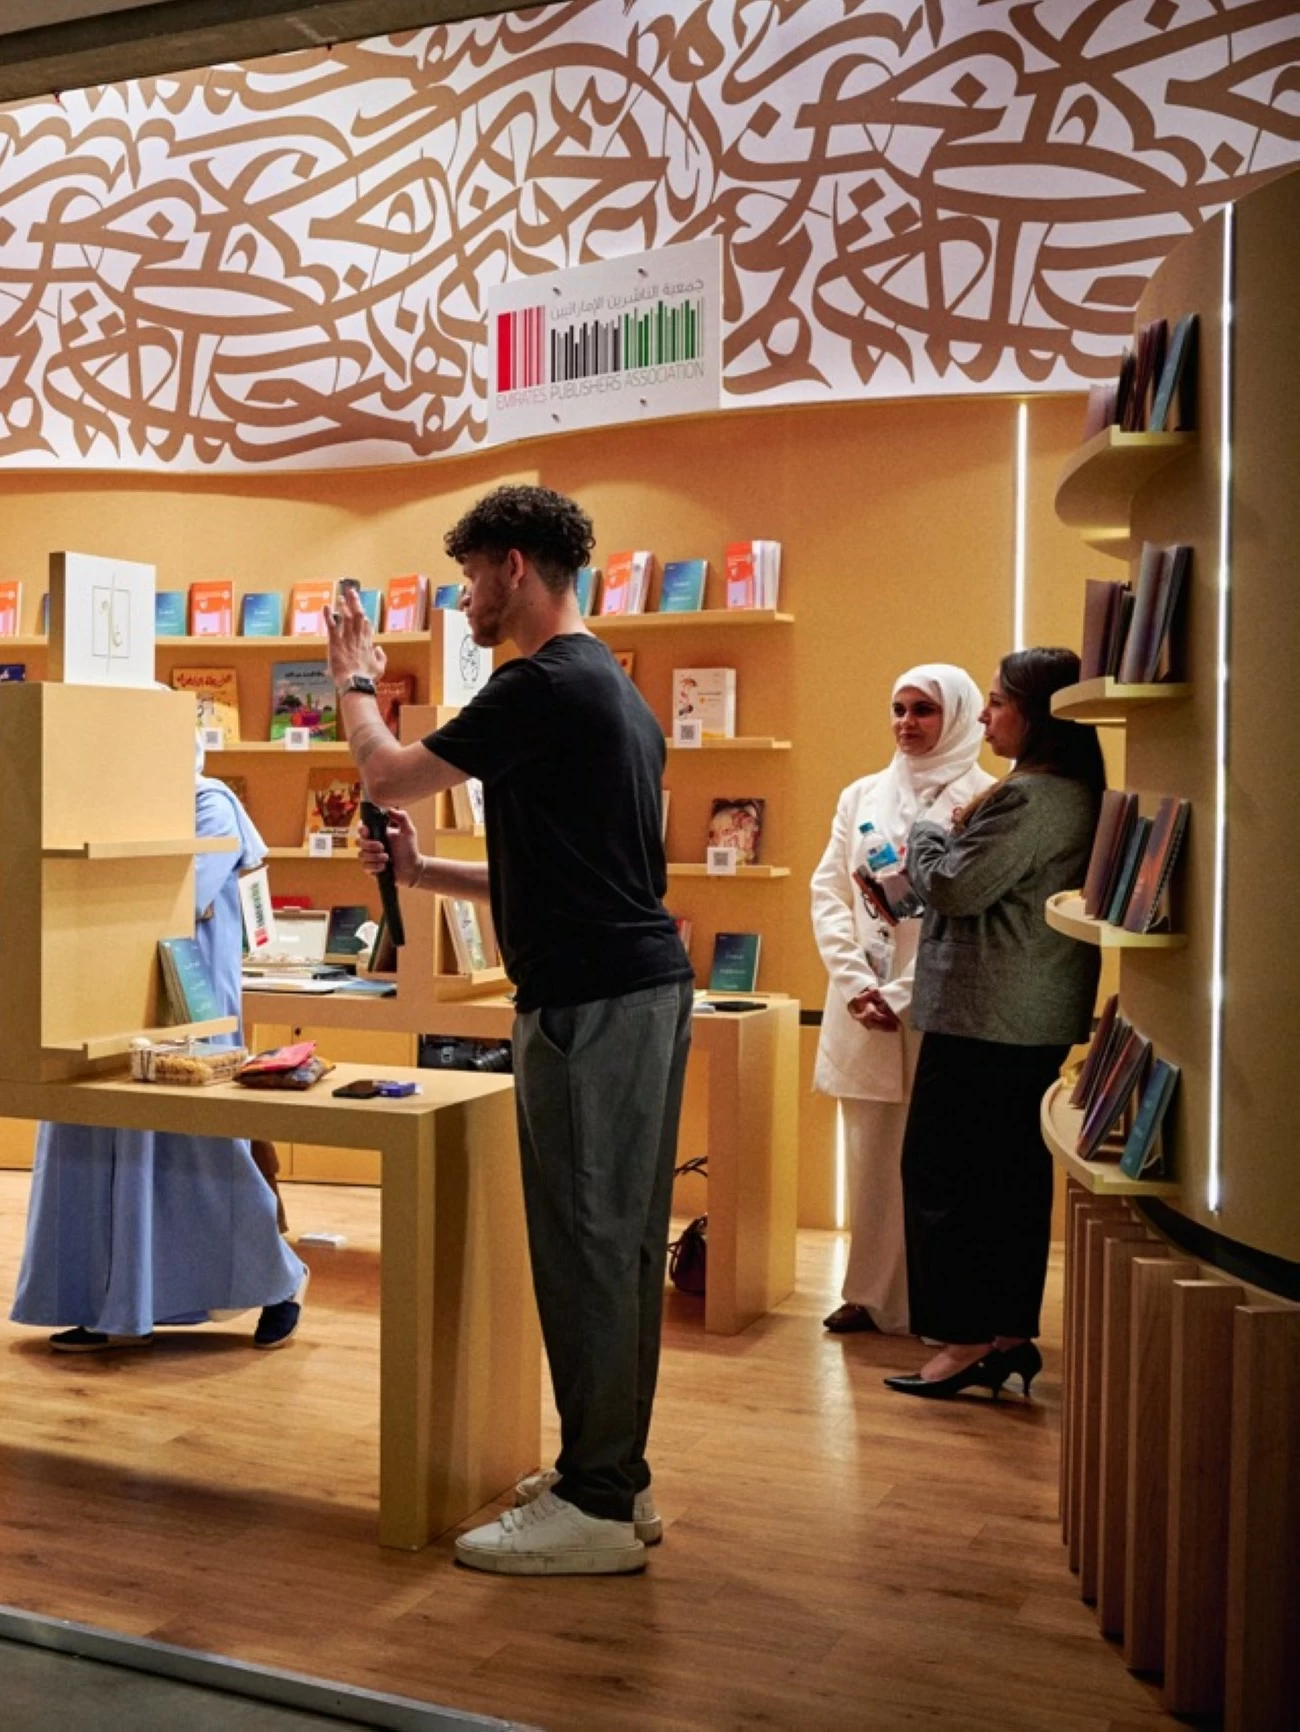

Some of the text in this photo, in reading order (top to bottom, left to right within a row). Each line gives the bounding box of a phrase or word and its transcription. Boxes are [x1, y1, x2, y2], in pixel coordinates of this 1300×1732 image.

[607, 284, 660, 309] الناشرين
[662, 279, 704, 296] جمعية
[496, 360, 705, 411] EMIRATES PUBLISHERS ASSOCIATION
